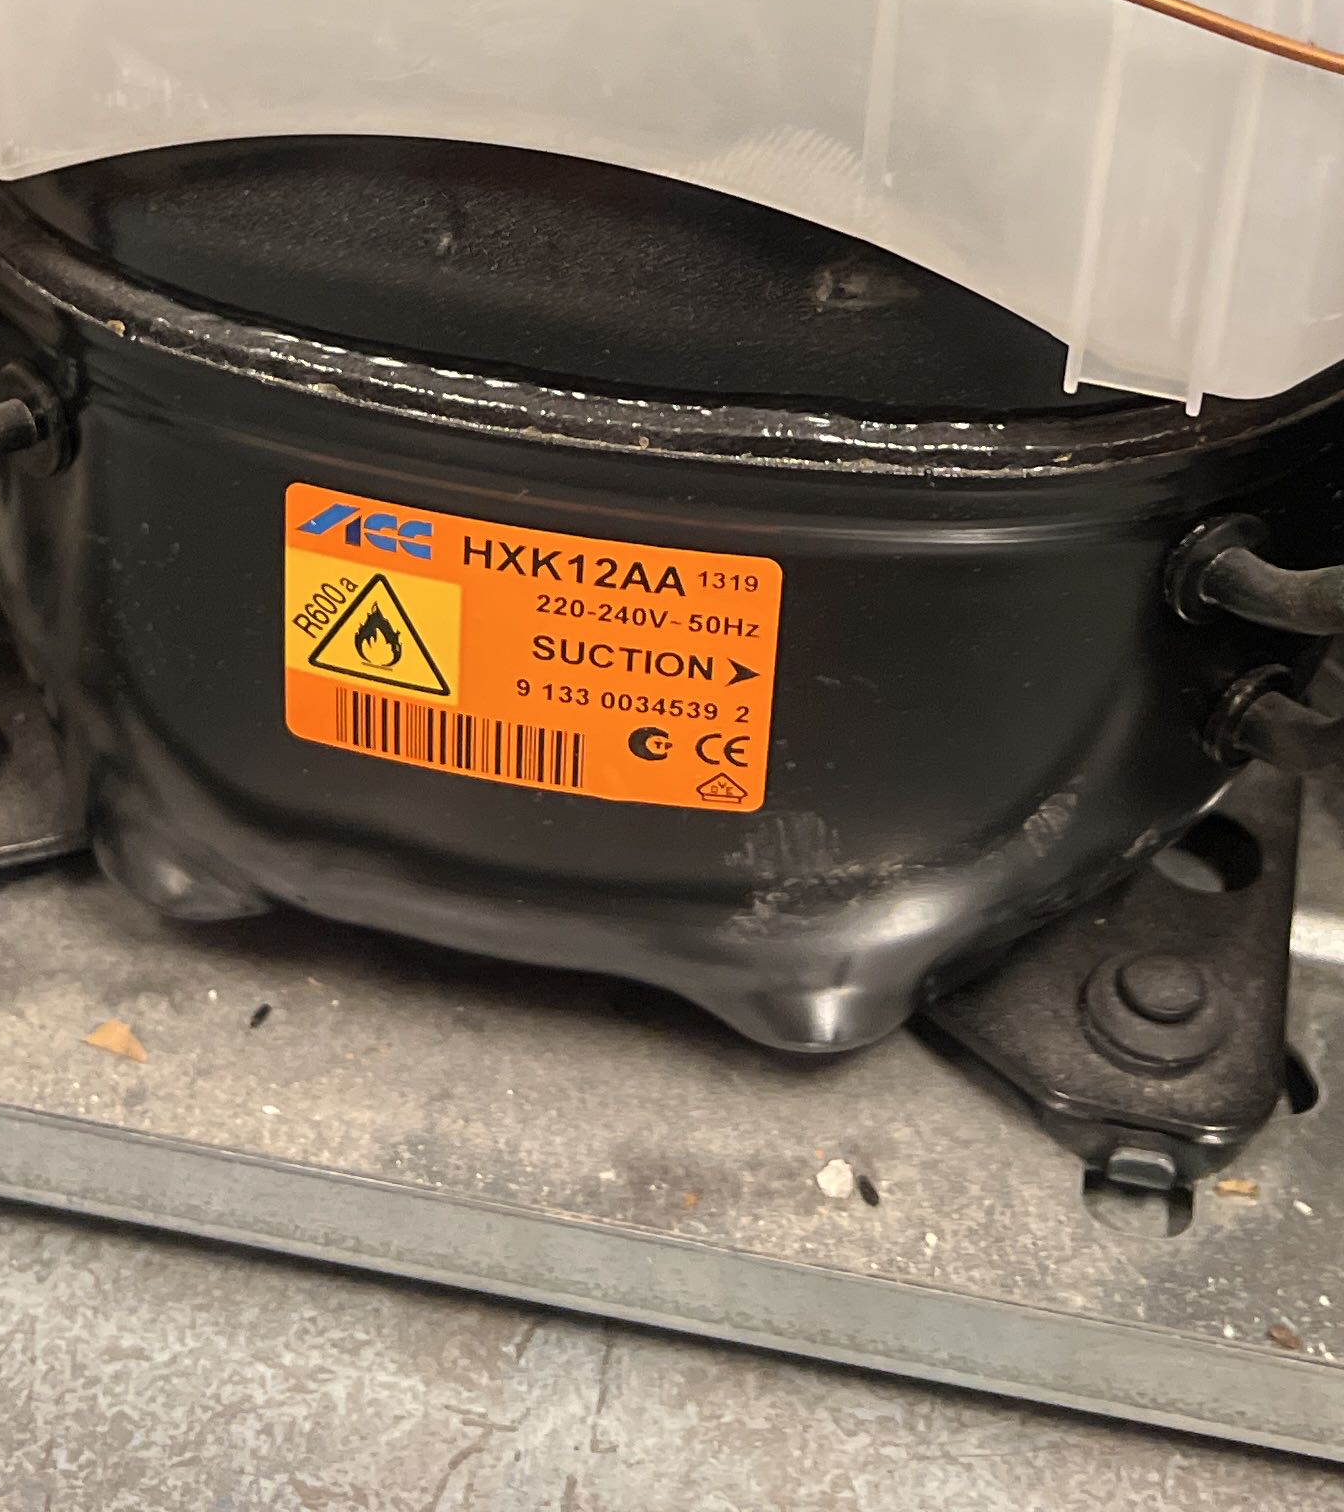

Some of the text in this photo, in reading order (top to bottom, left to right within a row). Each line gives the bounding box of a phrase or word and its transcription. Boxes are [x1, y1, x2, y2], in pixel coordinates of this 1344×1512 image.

[463, 535, 759, 597] HXK12AA 1319
[531, 634, 714, 681] SUCTION
[516, 678, 750, 724] 9 133 0034539 2
